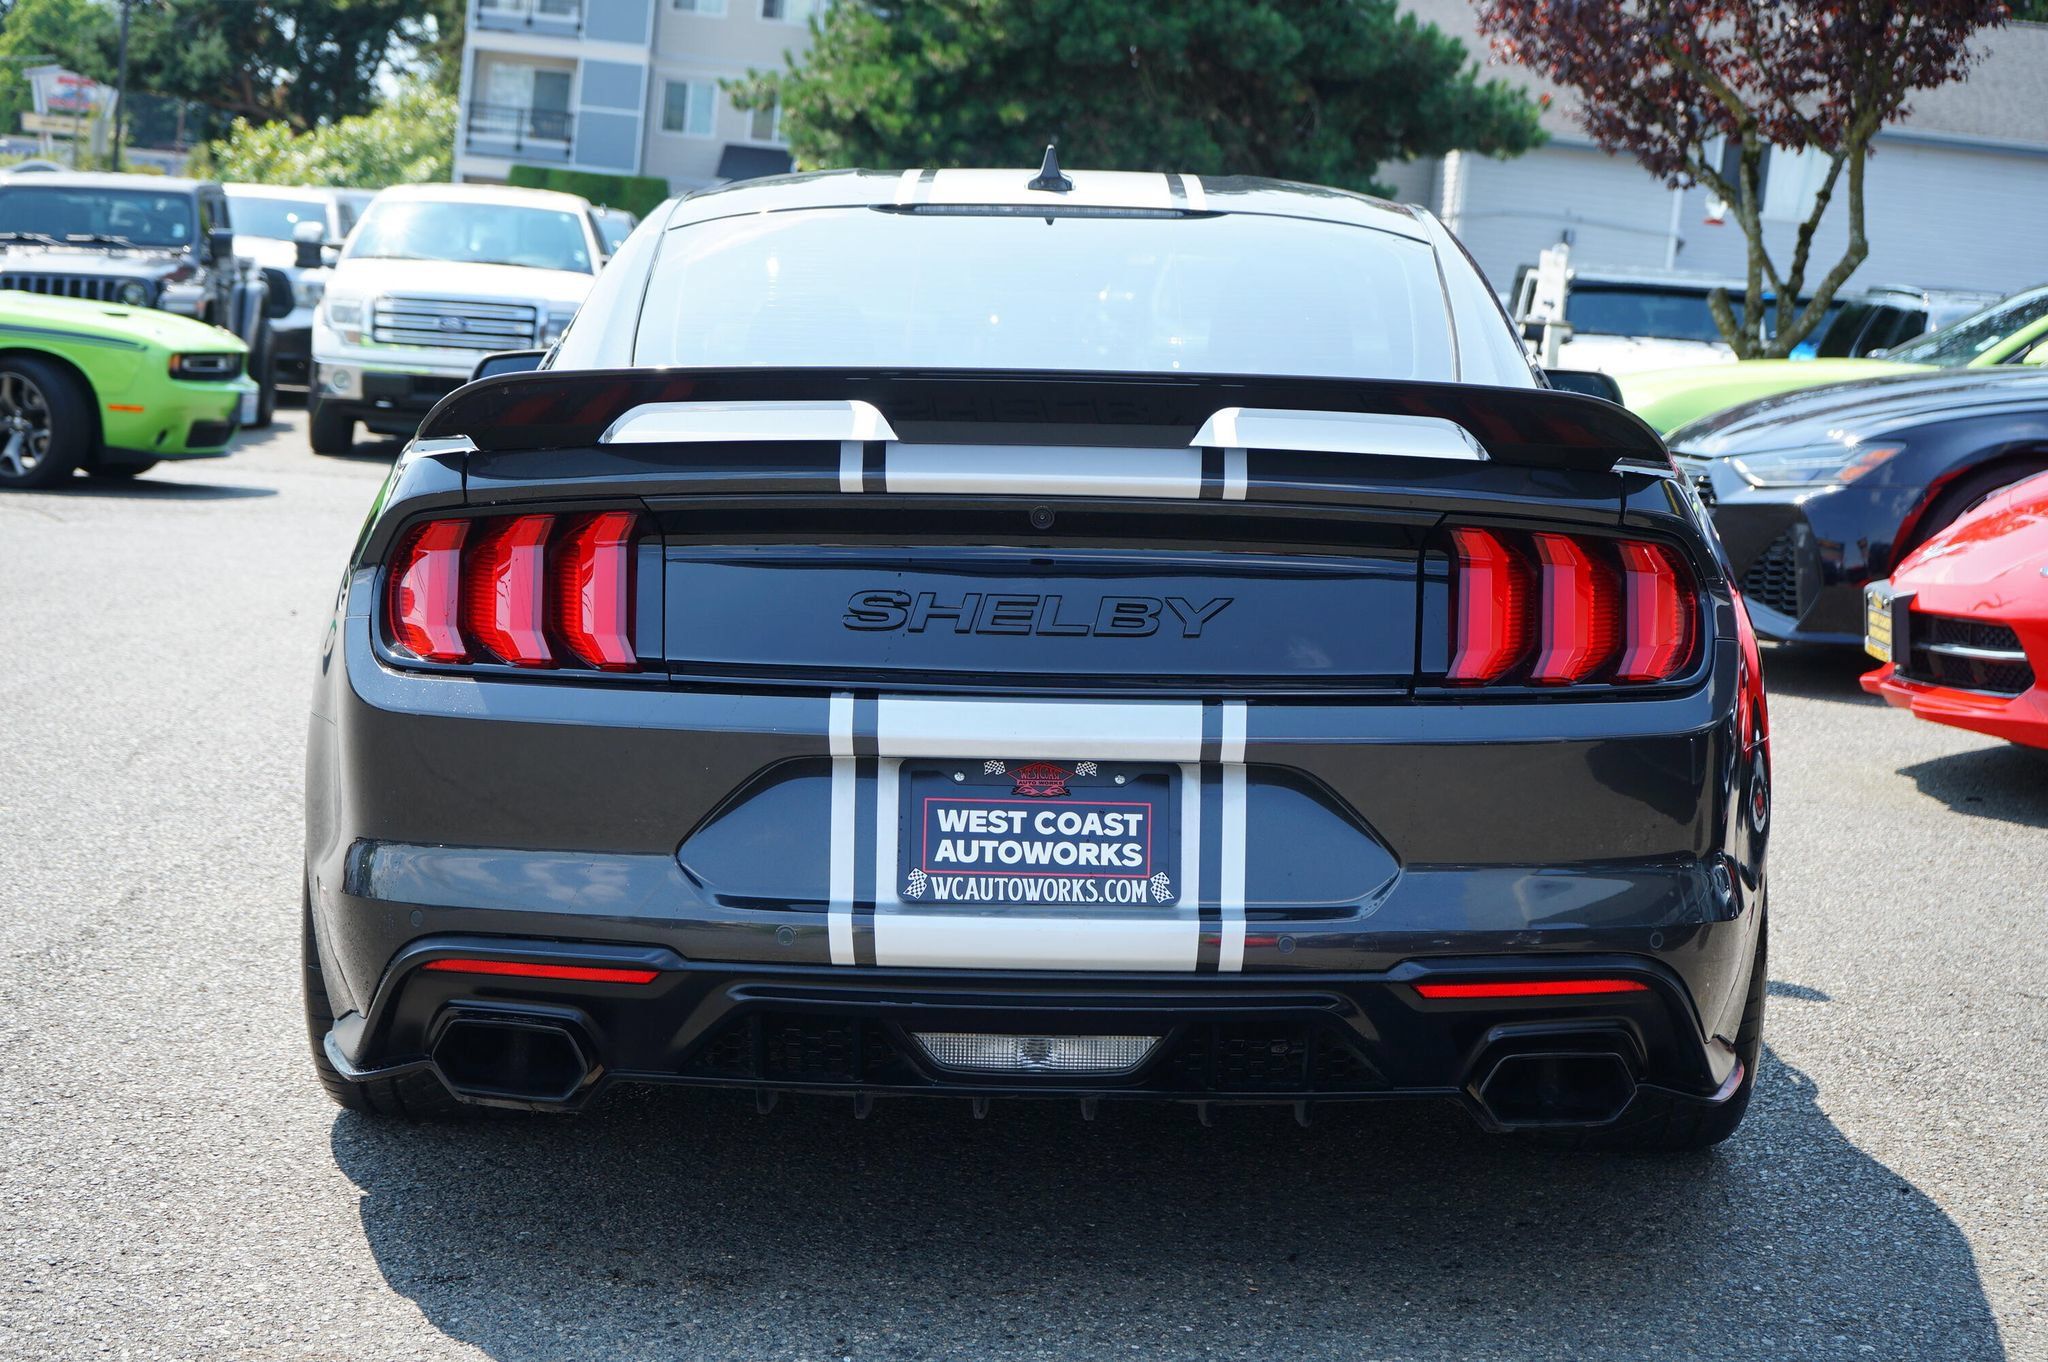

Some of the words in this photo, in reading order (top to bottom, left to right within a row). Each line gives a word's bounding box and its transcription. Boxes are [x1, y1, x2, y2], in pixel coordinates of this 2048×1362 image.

[842, 590, 1234, 639] SHELBY
[937, 809, 1027, 834] WEST
[1034, 811, 1143, 836] COAST
[934, 840, 1143, 867] AUTOWORKS
[931, 876, 1148, 903] WCAUTOWORKS.COM
